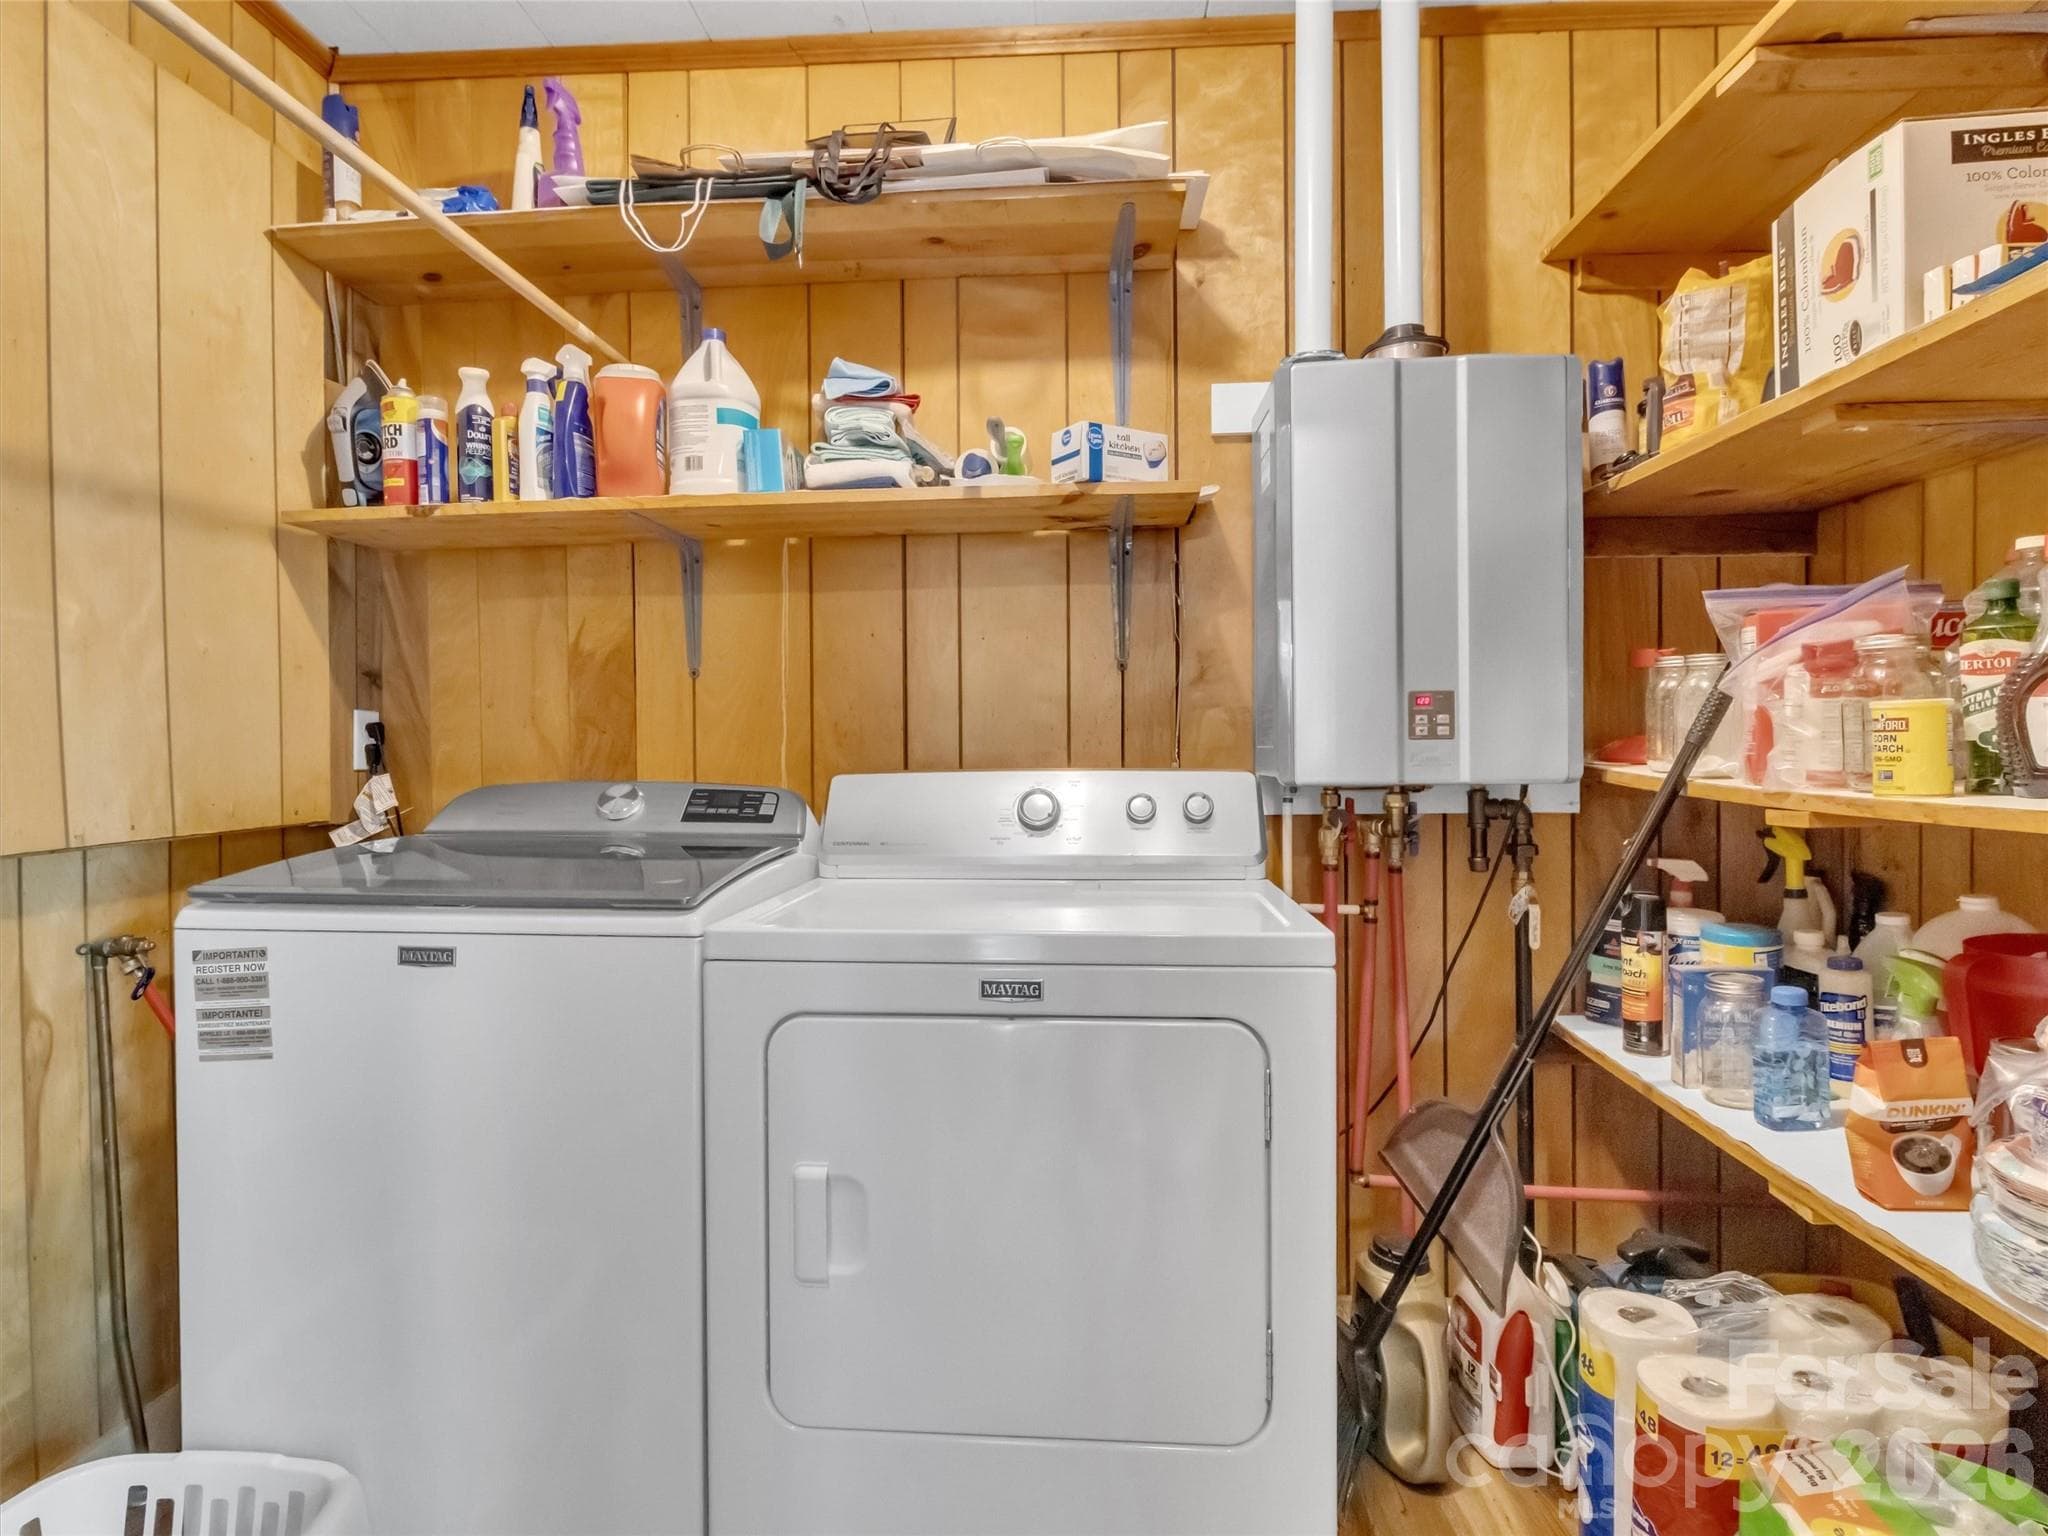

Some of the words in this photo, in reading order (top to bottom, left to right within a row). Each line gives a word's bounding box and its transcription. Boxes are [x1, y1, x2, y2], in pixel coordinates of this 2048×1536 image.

[1963, 130, 2036, 146] INGLES
[1966, 171, 2002, 182] 100%
[1778, 244, 1788, 293] BEST
[1799, 226, 1809, 312] Colombian
[1779, 298, 1789, 369] INGLES
[1833, 334, 1842, 363] 100
[1116, 433, 1131, 441] tall
[1108, 441, 1140, 453] kitchen
[202, 949, 259, 960] IMPORTANT!
[400, 950, 452, 962] MAYTAG
[195, 964, 241, 974] REGISTER
[243, 963, 266, 972] NOW
[983, 983, 1040, 996] MAYTAG
[201, 1009, 263, 1019] IMPORTANTE!
[1887, 1103, 1967, 1118] DUNKIN'
[1467, 1360, 1476, 1377] 12
[1580, 1352, 1595, 1377] 48
[1640, 1409, 1657, 1434] 48
